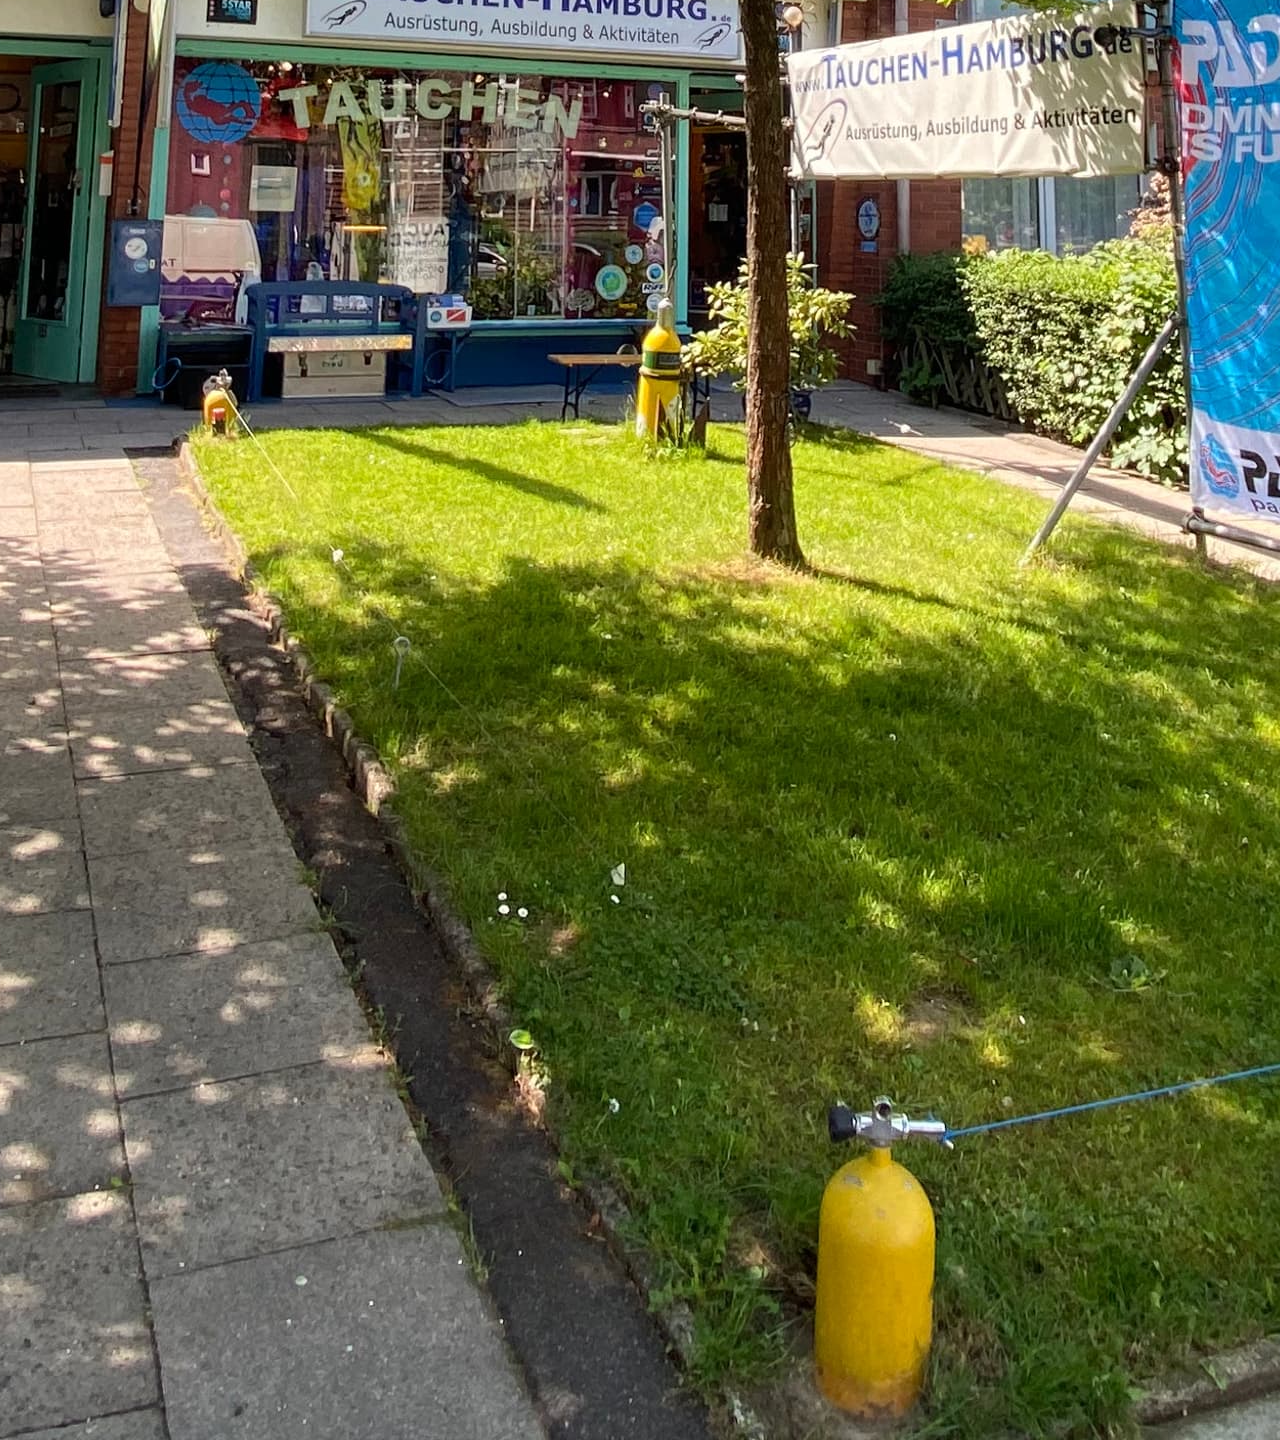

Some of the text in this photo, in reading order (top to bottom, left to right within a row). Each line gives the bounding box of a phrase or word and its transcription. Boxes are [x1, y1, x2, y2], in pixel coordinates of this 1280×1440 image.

[384, 12, 680, 44] Ausrüstung, Ausbildung & Aktivitäten
[279, 77, 583, 139] TAUCHEN
[846, 106, 1137, 141] Ausrüstung, Ausbildung & Aktivitäten
